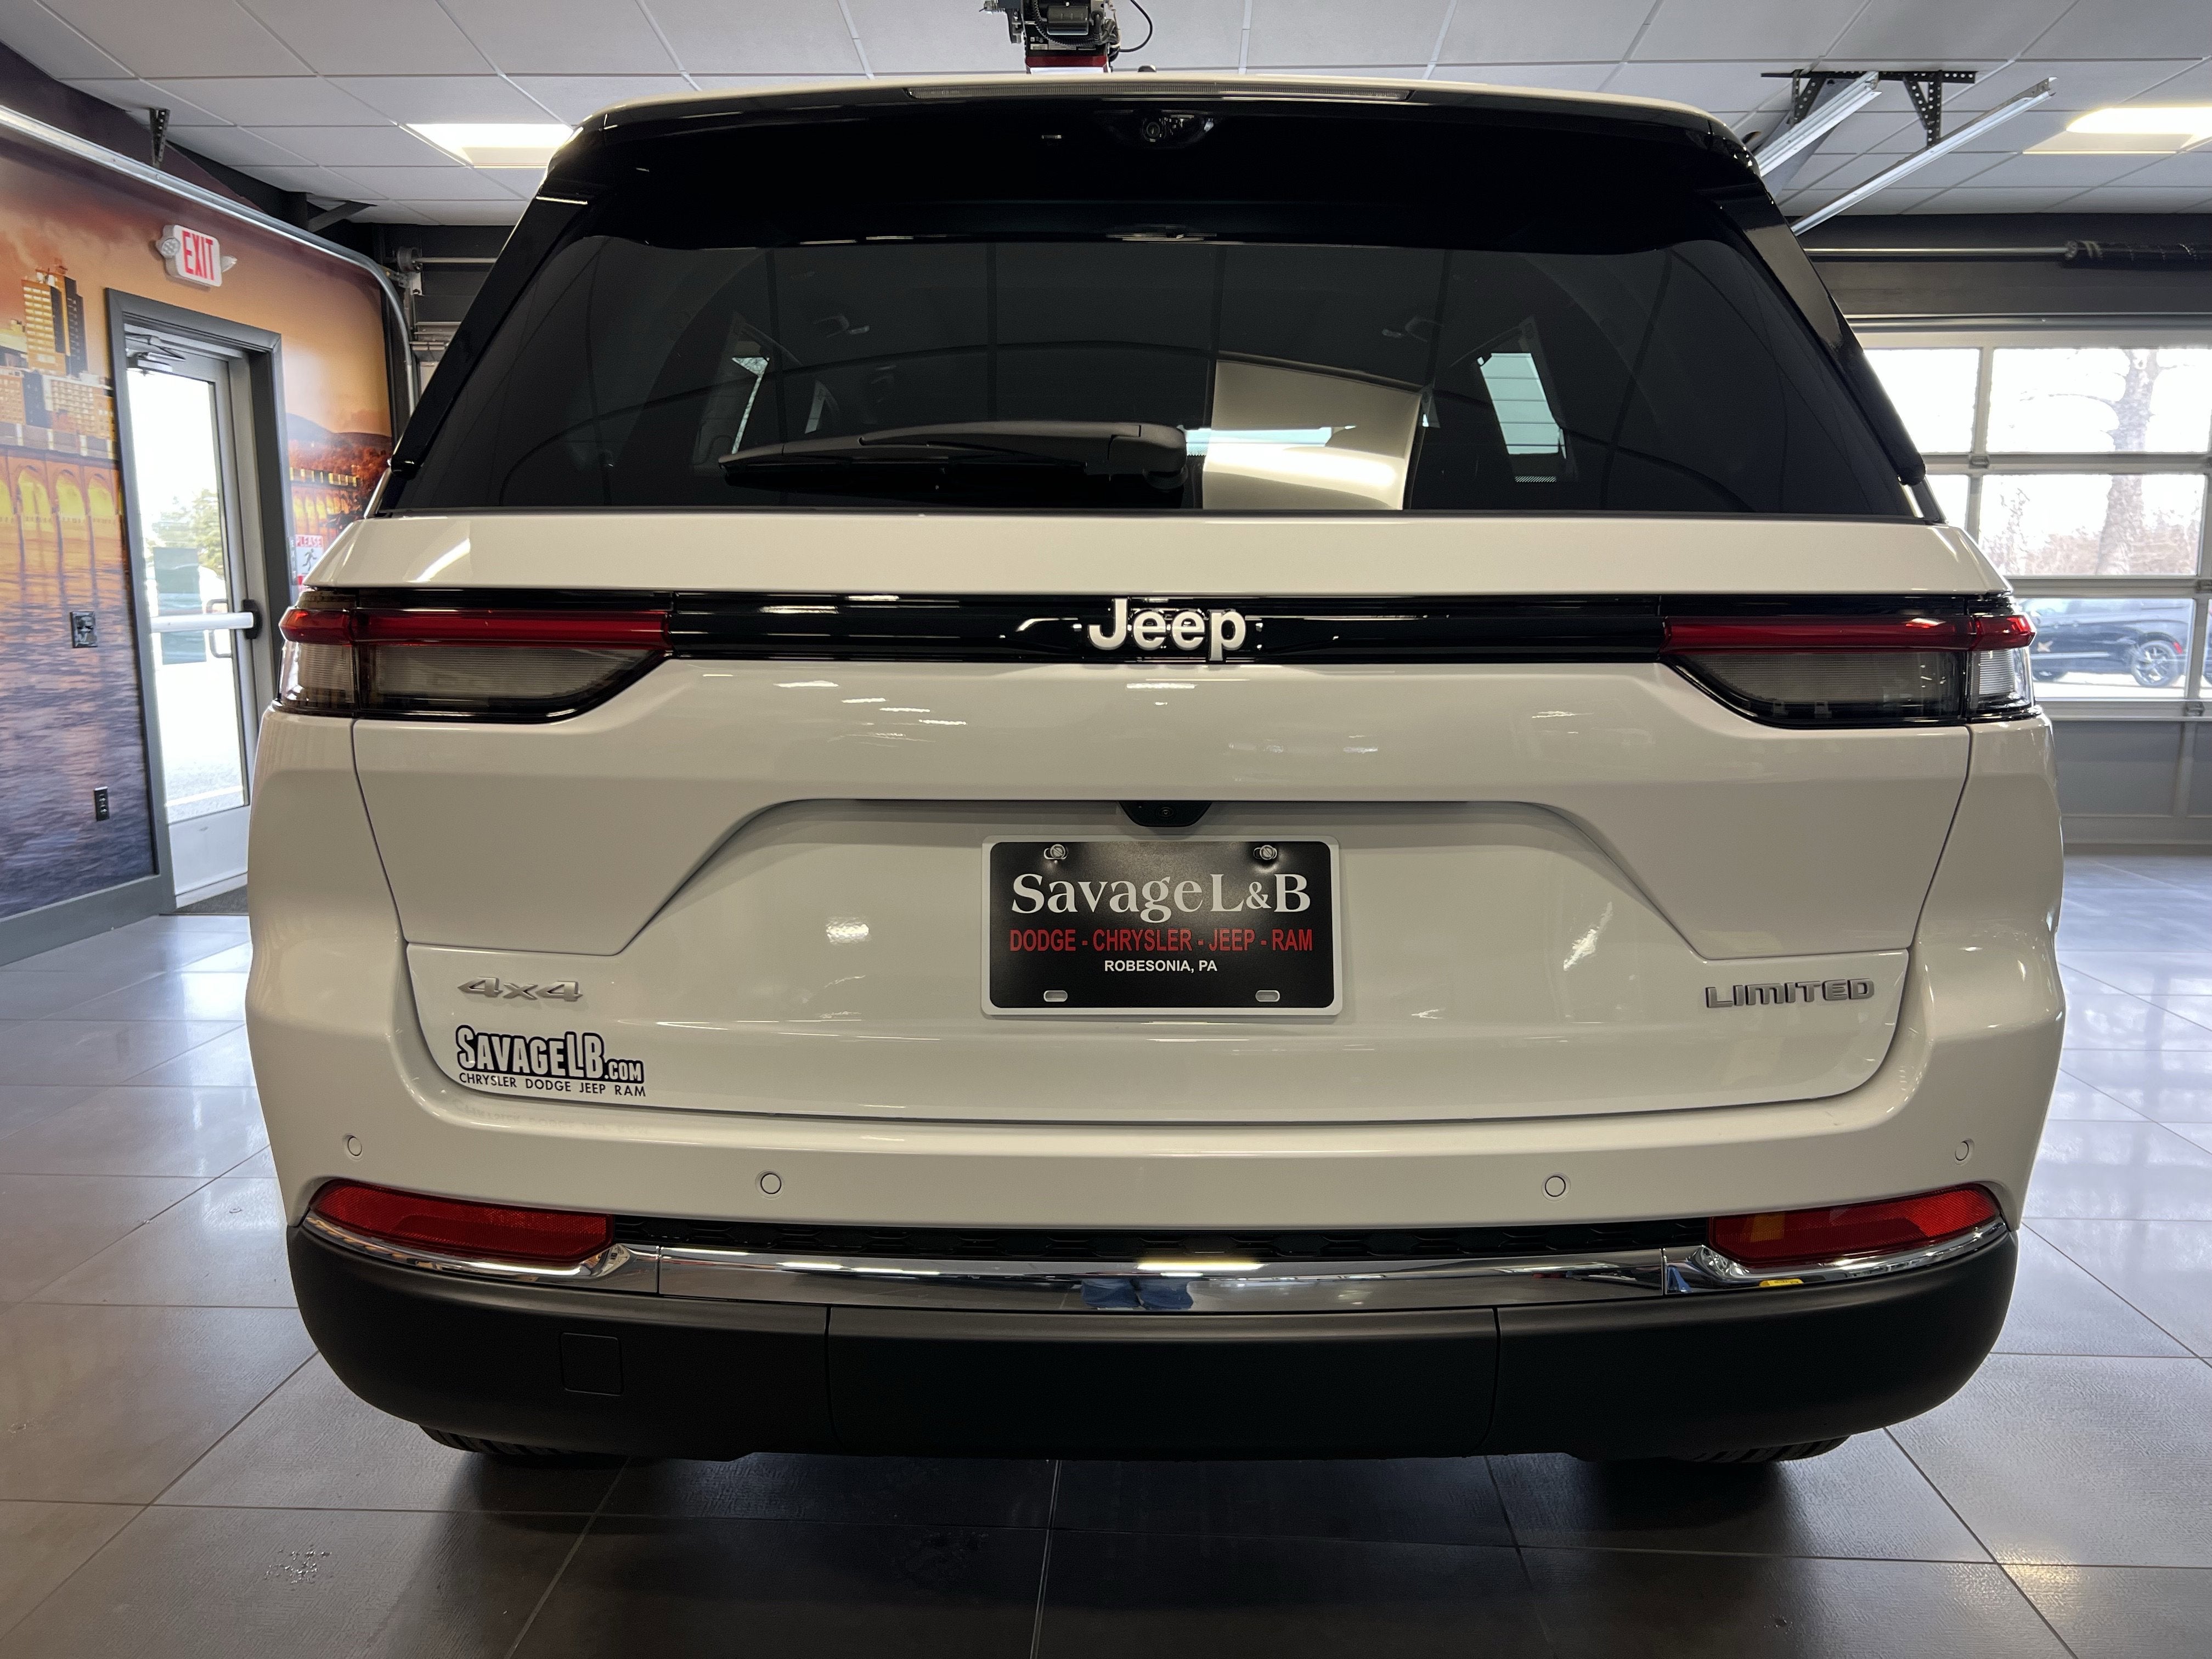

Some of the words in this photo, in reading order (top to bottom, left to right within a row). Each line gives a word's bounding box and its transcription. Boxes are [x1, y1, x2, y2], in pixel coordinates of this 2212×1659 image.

[182, 230, 215, 281] EXIT
[296, 535, 322, 547] PLEASE
[1087, 597, 1247, 662] Jeep
[1011, 873, 1202, 923] Savage
[1210, 874, 1311, 913] L&B
[1010, 929, 1076, 952] DODGE
[1092, 929, 1193, 952] CHRYSLER
[1209, 929, 1256, 952] JEEP
[1272, 929, 1313, 951] RAM
[1104, 960, 1195, 974] ROBESONIA,
[1198, 960, 1217, 972] PA
[457, 977, 584, 1002] 4x4
[1705, 978, 1875, 1008] LIMITED
[459, 1073, 517, 1088] CHRYSLER
[526, 1079, 572, 1092] DODGE
[579, 1082, 606, 1094] JEEP
[615, 1085, 646, 1097] RAM
